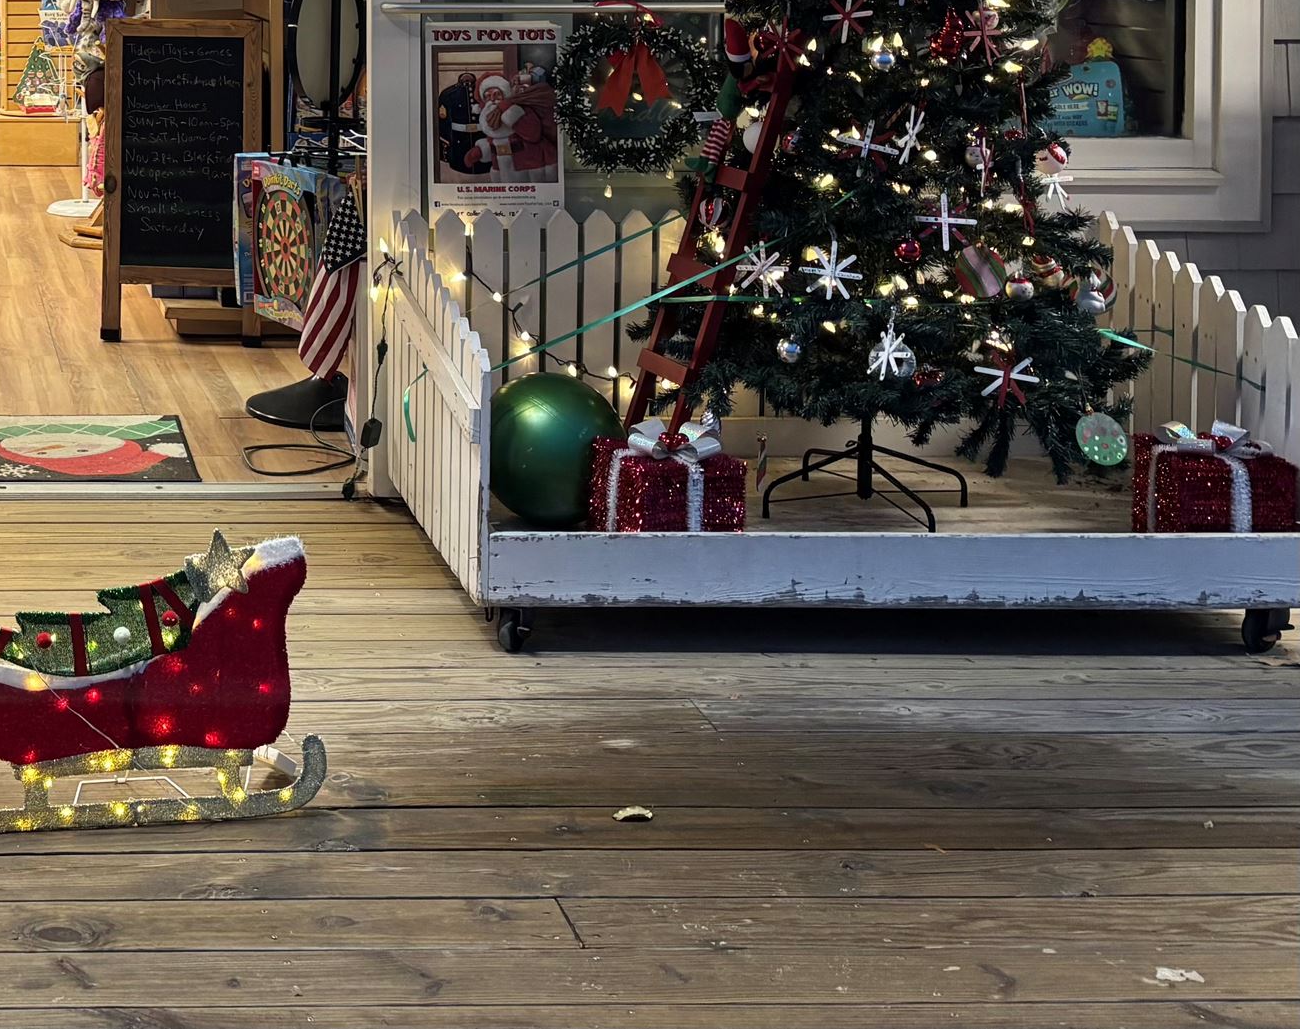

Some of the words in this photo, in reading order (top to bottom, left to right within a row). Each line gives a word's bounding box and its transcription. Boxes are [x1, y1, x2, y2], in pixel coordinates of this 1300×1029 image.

[432, 29, 472, 42] TOYS
[476, 29, 513, 42] FOR
[517, 28, 556, 41] TOTS
[1062, 82, 1099, 97] WOW!
